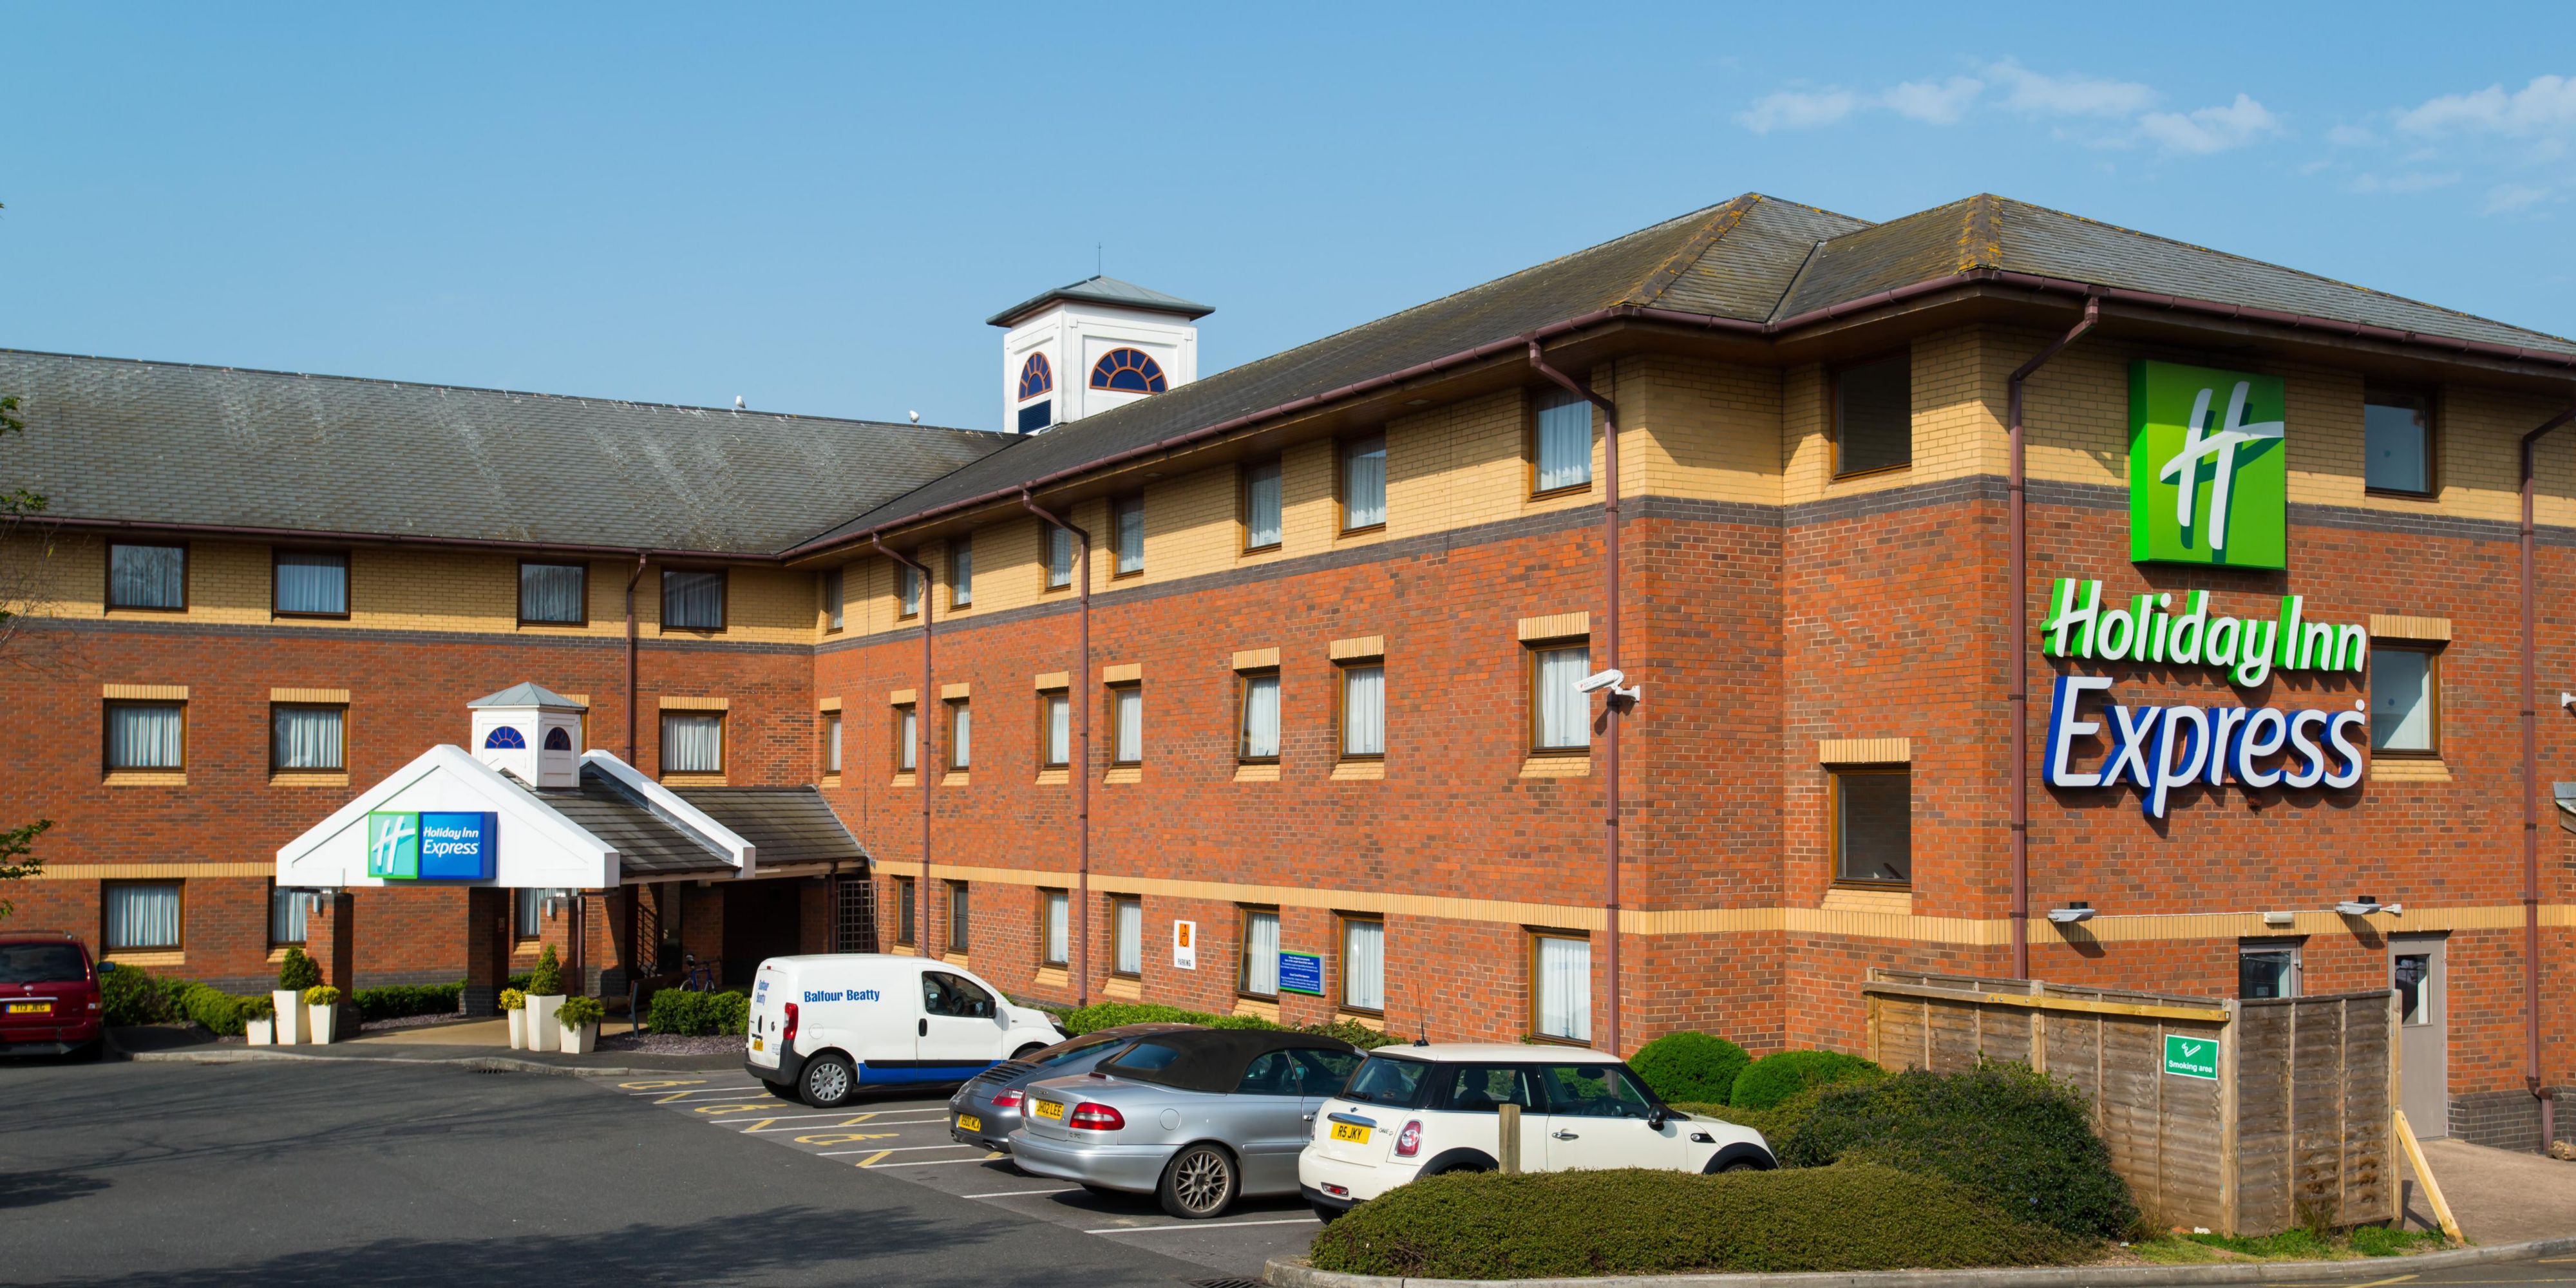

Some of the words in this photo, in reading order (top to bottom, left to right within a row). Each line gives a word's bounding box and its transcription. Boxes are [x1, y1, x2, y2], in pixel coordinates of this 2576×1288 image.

[2041, 578, 2277, 687] Holiday
[2277, 595, 2365, 672] Inn
[2044, 676, 2365, 819] Express
[423, 826, 460, 840] Holiday
[462, 827, 478, 838] Inn
[422, 839, 478, 858] Express
[758, 980, 770, 991] Balfour
[756, 992, 766, 1006] Beatty
[804, 990, 843, 1003] Balfour
[846, 989, 880, 1002] Beatty
[2168, 1059, 2197, 1072] Smoking
[1050, 1103, 1063, 1117] LEE
[1338, 1126, 1348, 1138] R5
[1347, 1128, 1363, 1140] JKY
